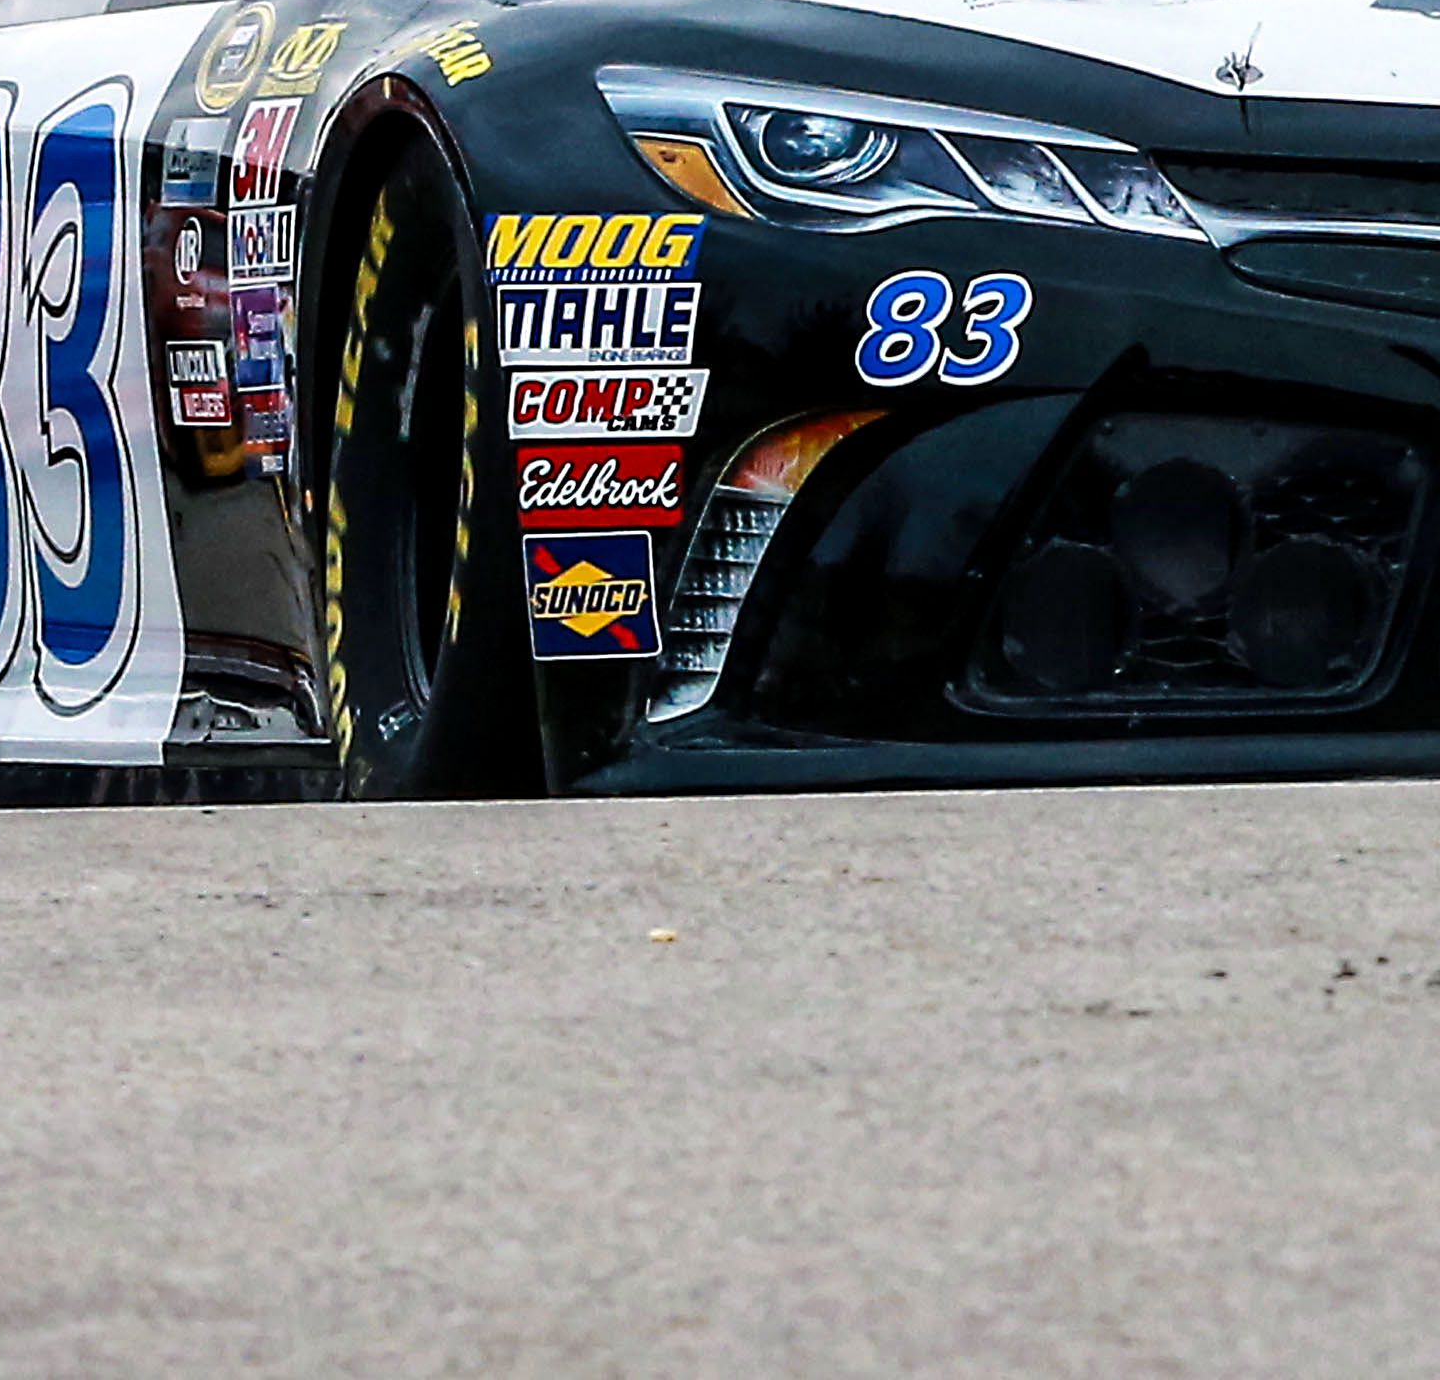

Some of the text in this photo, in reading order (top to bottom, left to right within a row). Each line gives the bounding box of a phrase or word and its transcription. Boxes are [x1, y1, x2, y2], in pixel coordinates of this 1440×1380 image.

[487, 213, 705, 269] MOOG
[500, 287, 696, 350] MAHLE
[855, 269, 1034, 388] 83
[631, 348, 688, 363] BEARINGS
[512, 378, 655, 426] COMP
[606, 414, 678, 432] CAMS
[519, 458, 680, 509] Edelbrock
[533, 582, 645, 615] SUNOCO
